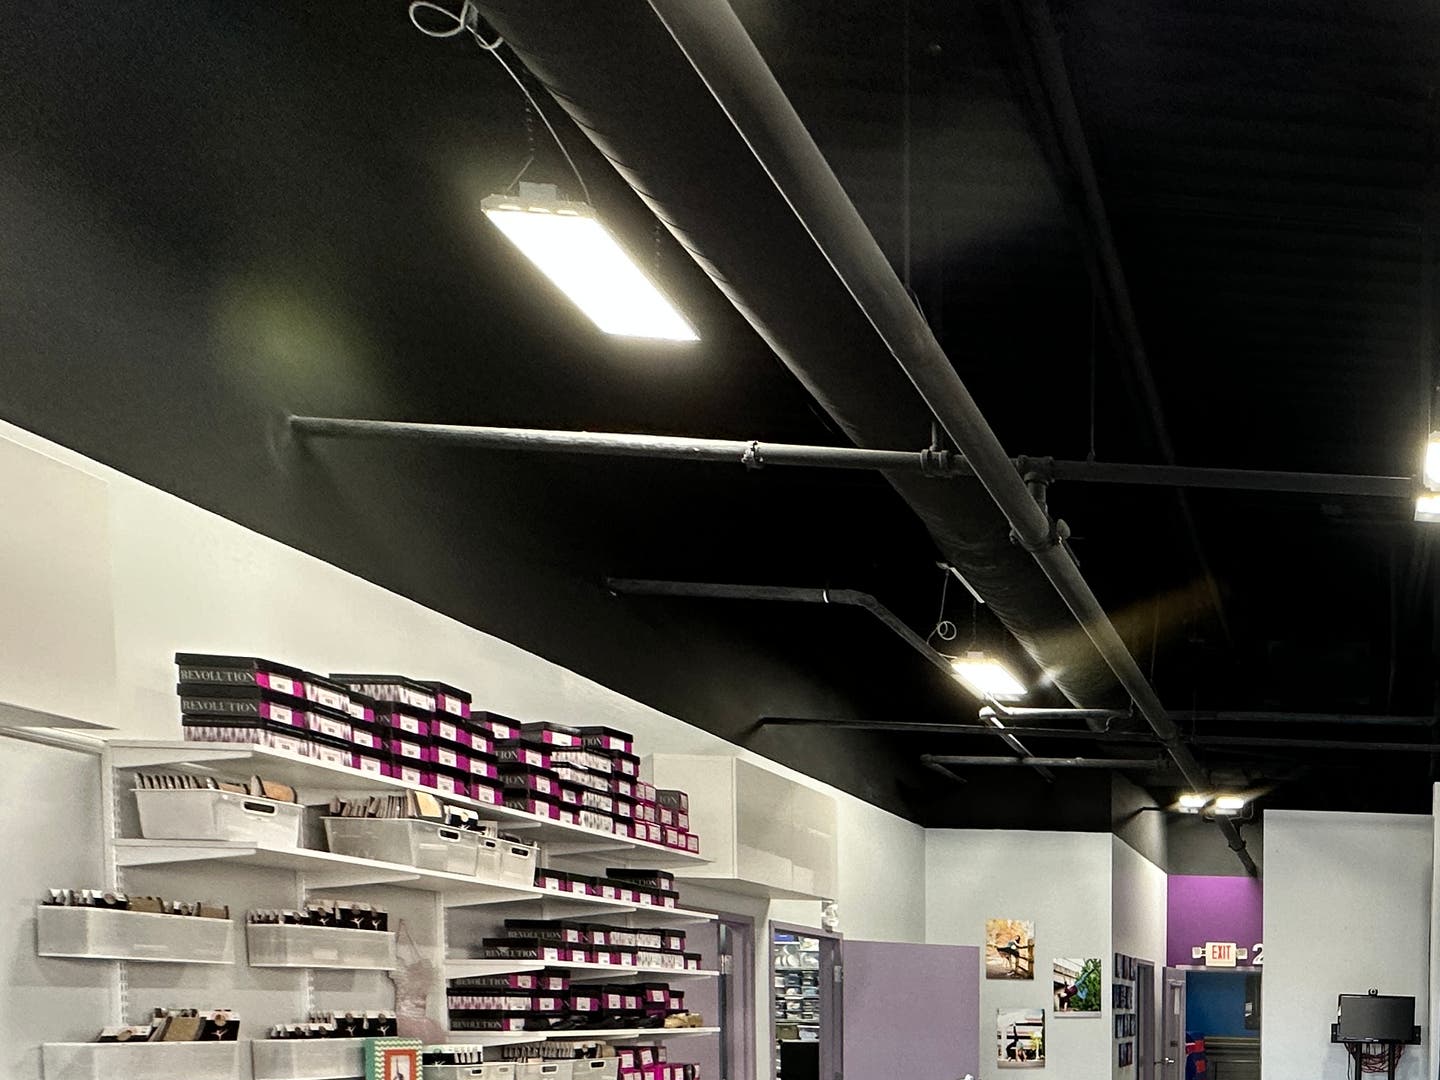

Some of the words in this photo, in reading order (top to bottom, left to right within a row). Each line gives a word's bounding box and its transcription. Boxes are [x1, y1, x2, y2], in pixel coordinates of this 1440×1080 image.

[181, 668, 256, 682] REVOLUTION
[183, 701, 257, 713] REVOLUTION
[1212, 945, 1231, 960] EXIT
